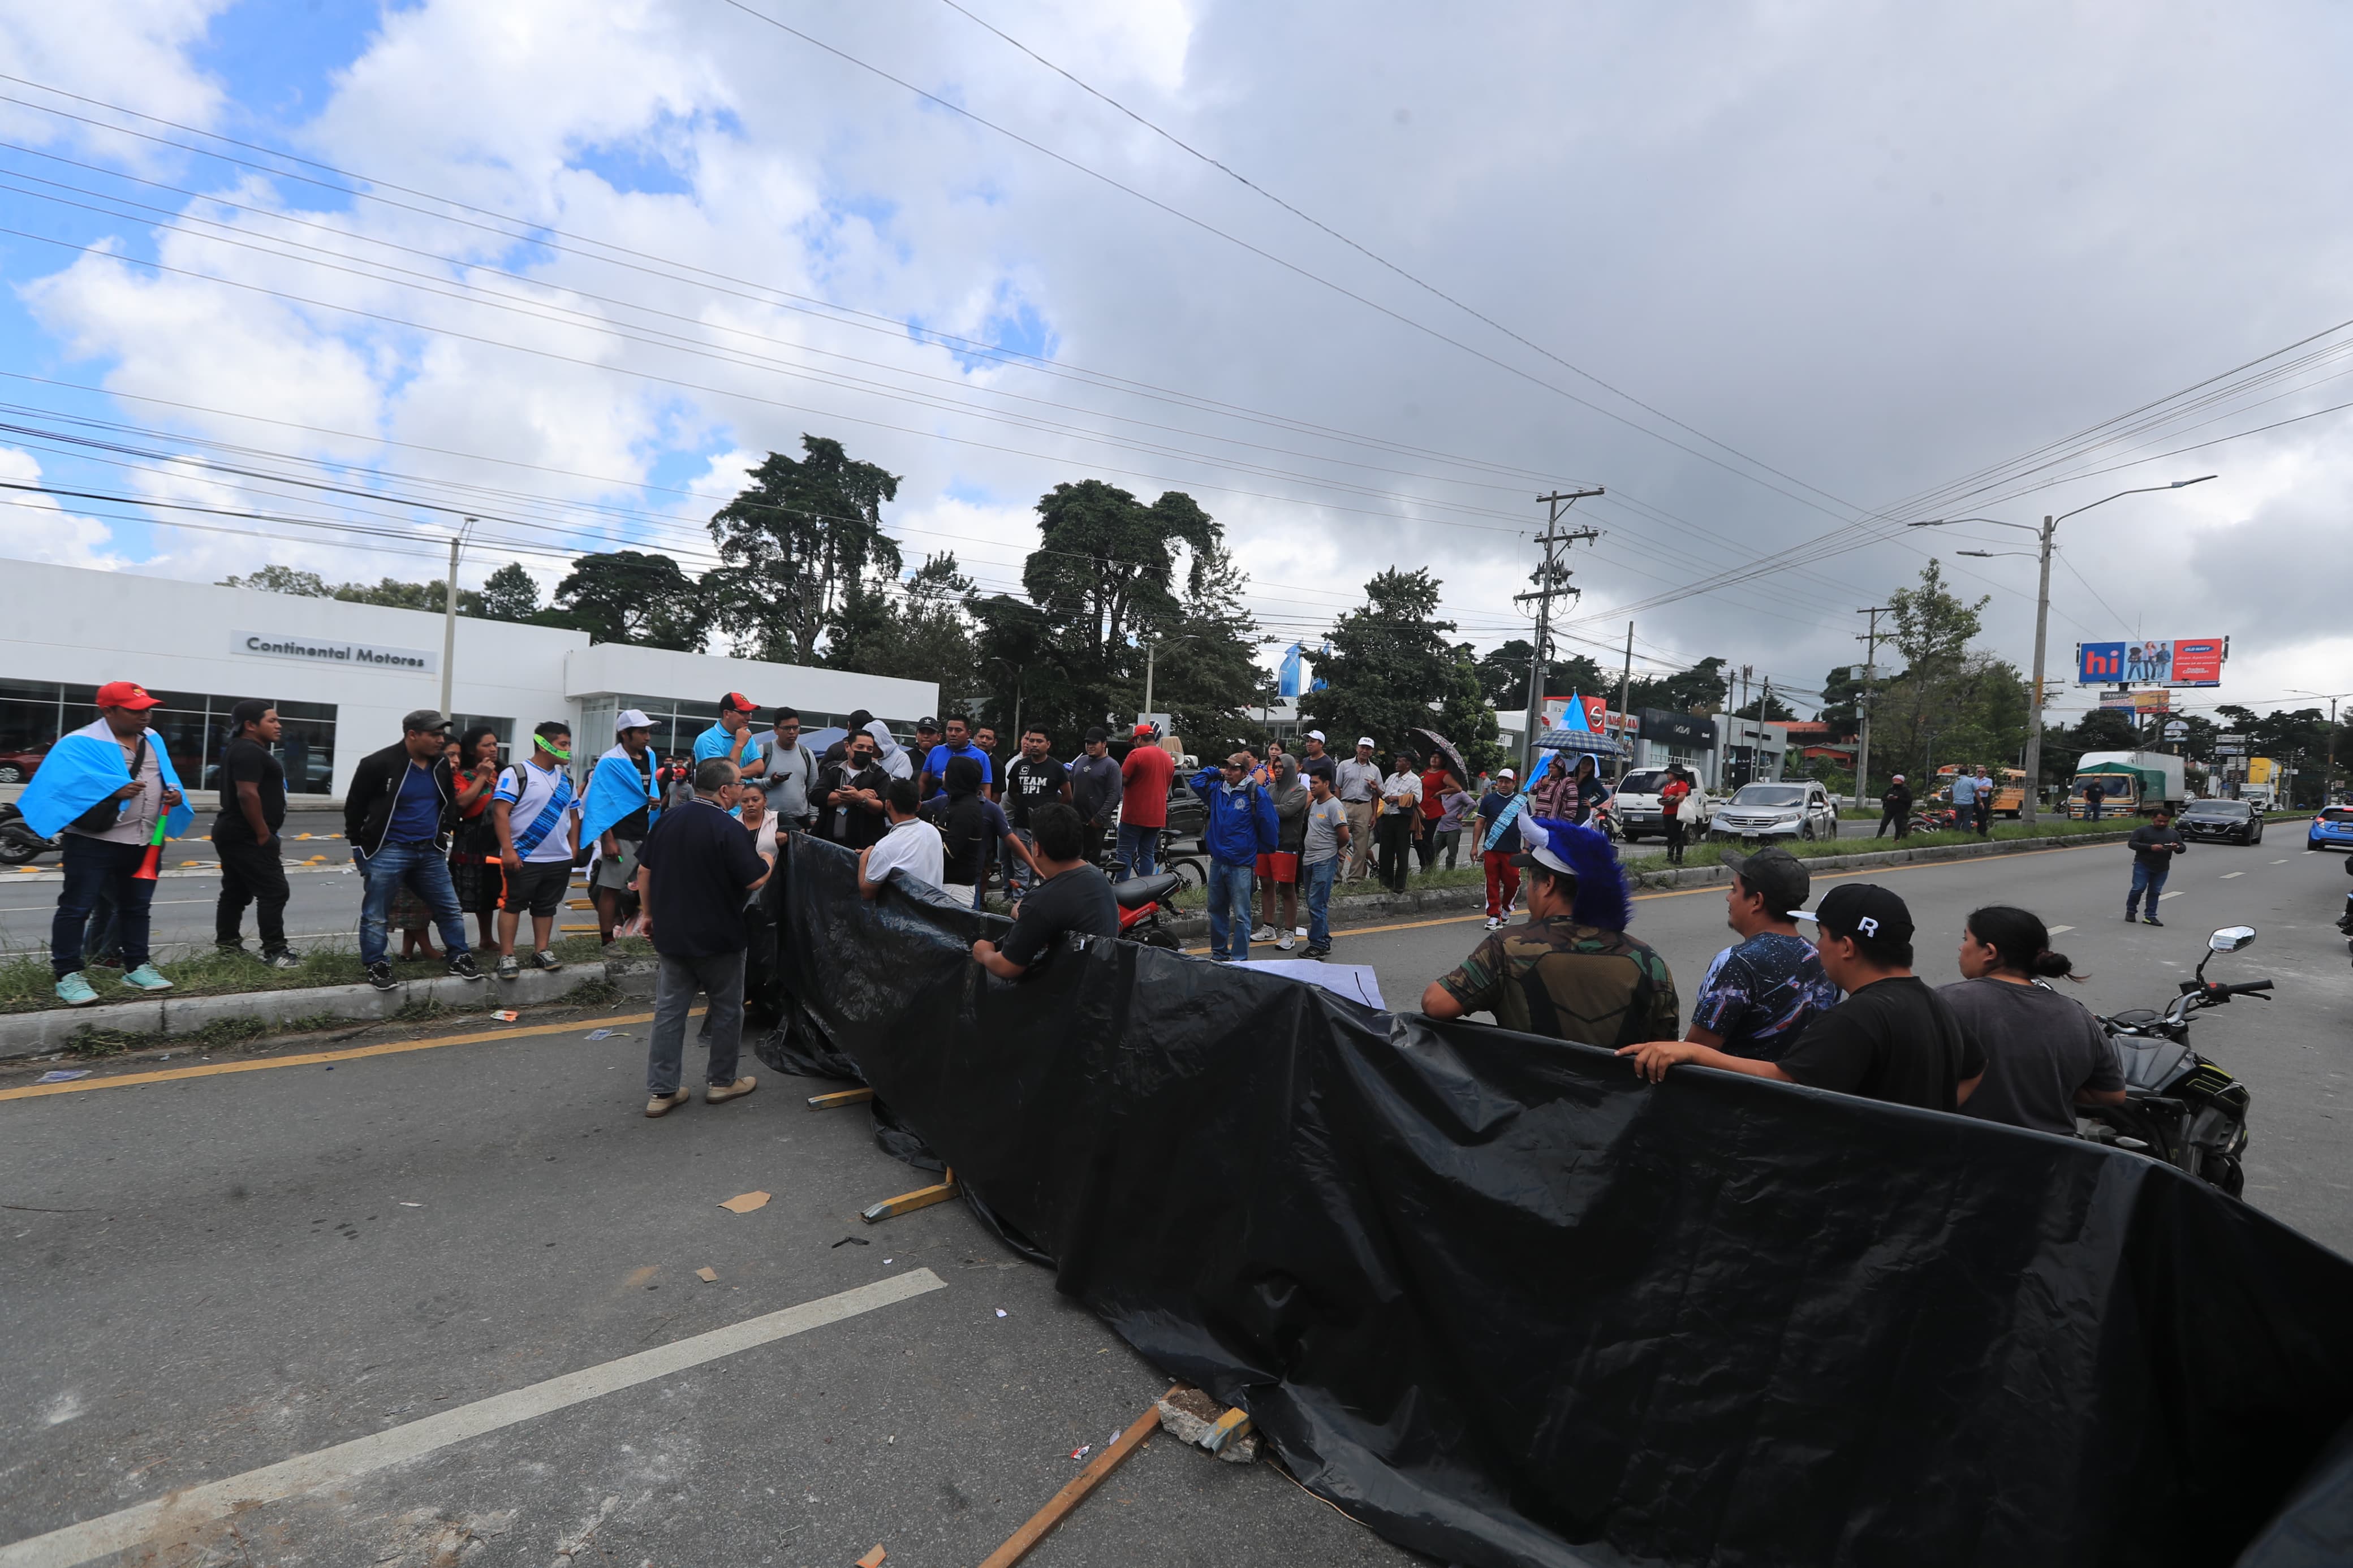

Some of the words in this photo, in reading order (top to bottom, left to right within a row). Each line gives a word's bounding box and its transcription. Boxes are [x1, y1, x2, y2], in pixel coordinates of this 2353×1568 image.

[246, 637, 351, 660] Continental
[356, 649, 425, 667] Motores
[2085, 650, 2119, 674] hi
[1018, 776, 1048, 787] TEAM
[1022, 785, 1040, 794] BPI
[1857, 916, 1879, 938] R
